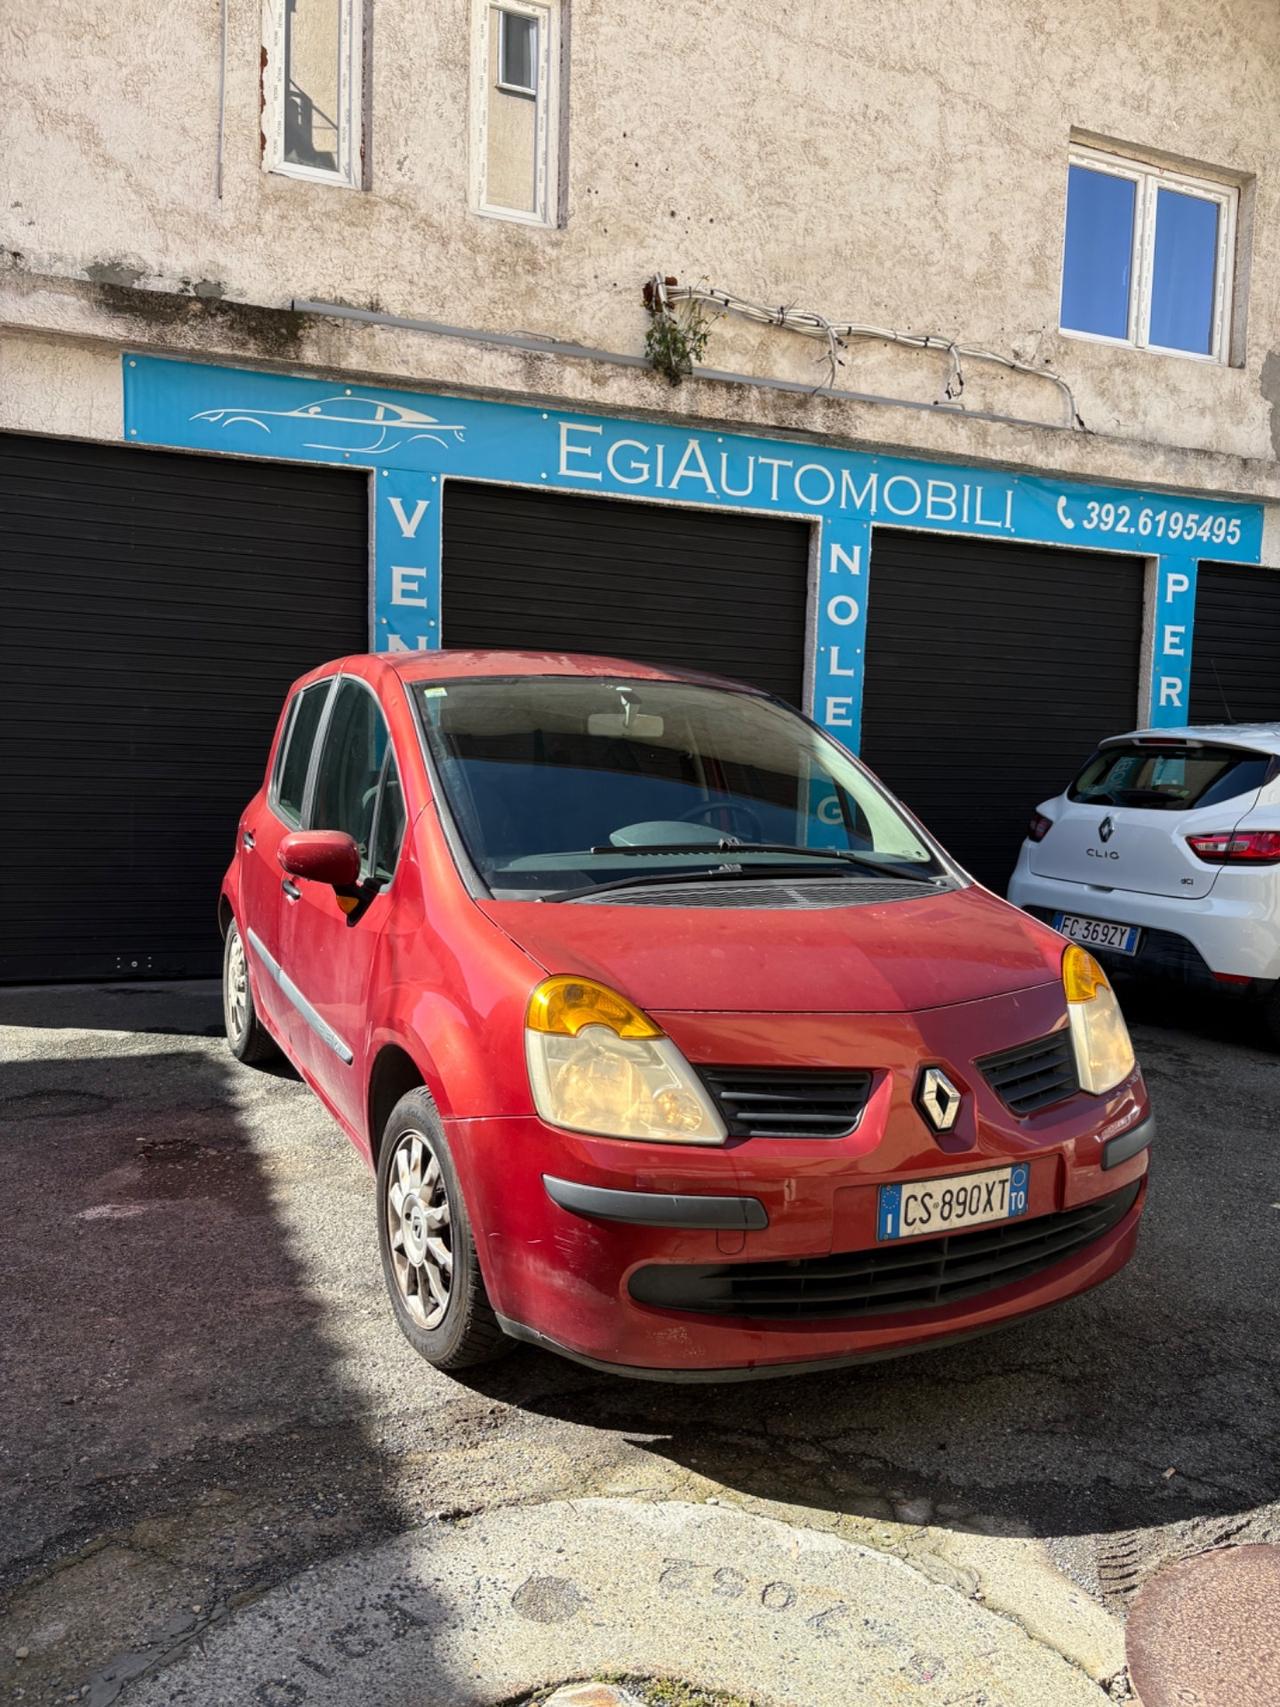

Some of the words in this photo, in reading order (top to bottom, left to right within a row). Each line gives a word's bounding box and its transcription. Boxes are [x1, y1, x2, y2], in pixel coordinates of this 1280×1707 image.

[1082, 500, 1242, 545] 392.6195495
[1158, 572, 1190, 707] PER
[1086, 847, 1120, 860] CLIO
[1010, 1190, 1025, 1211] TO
